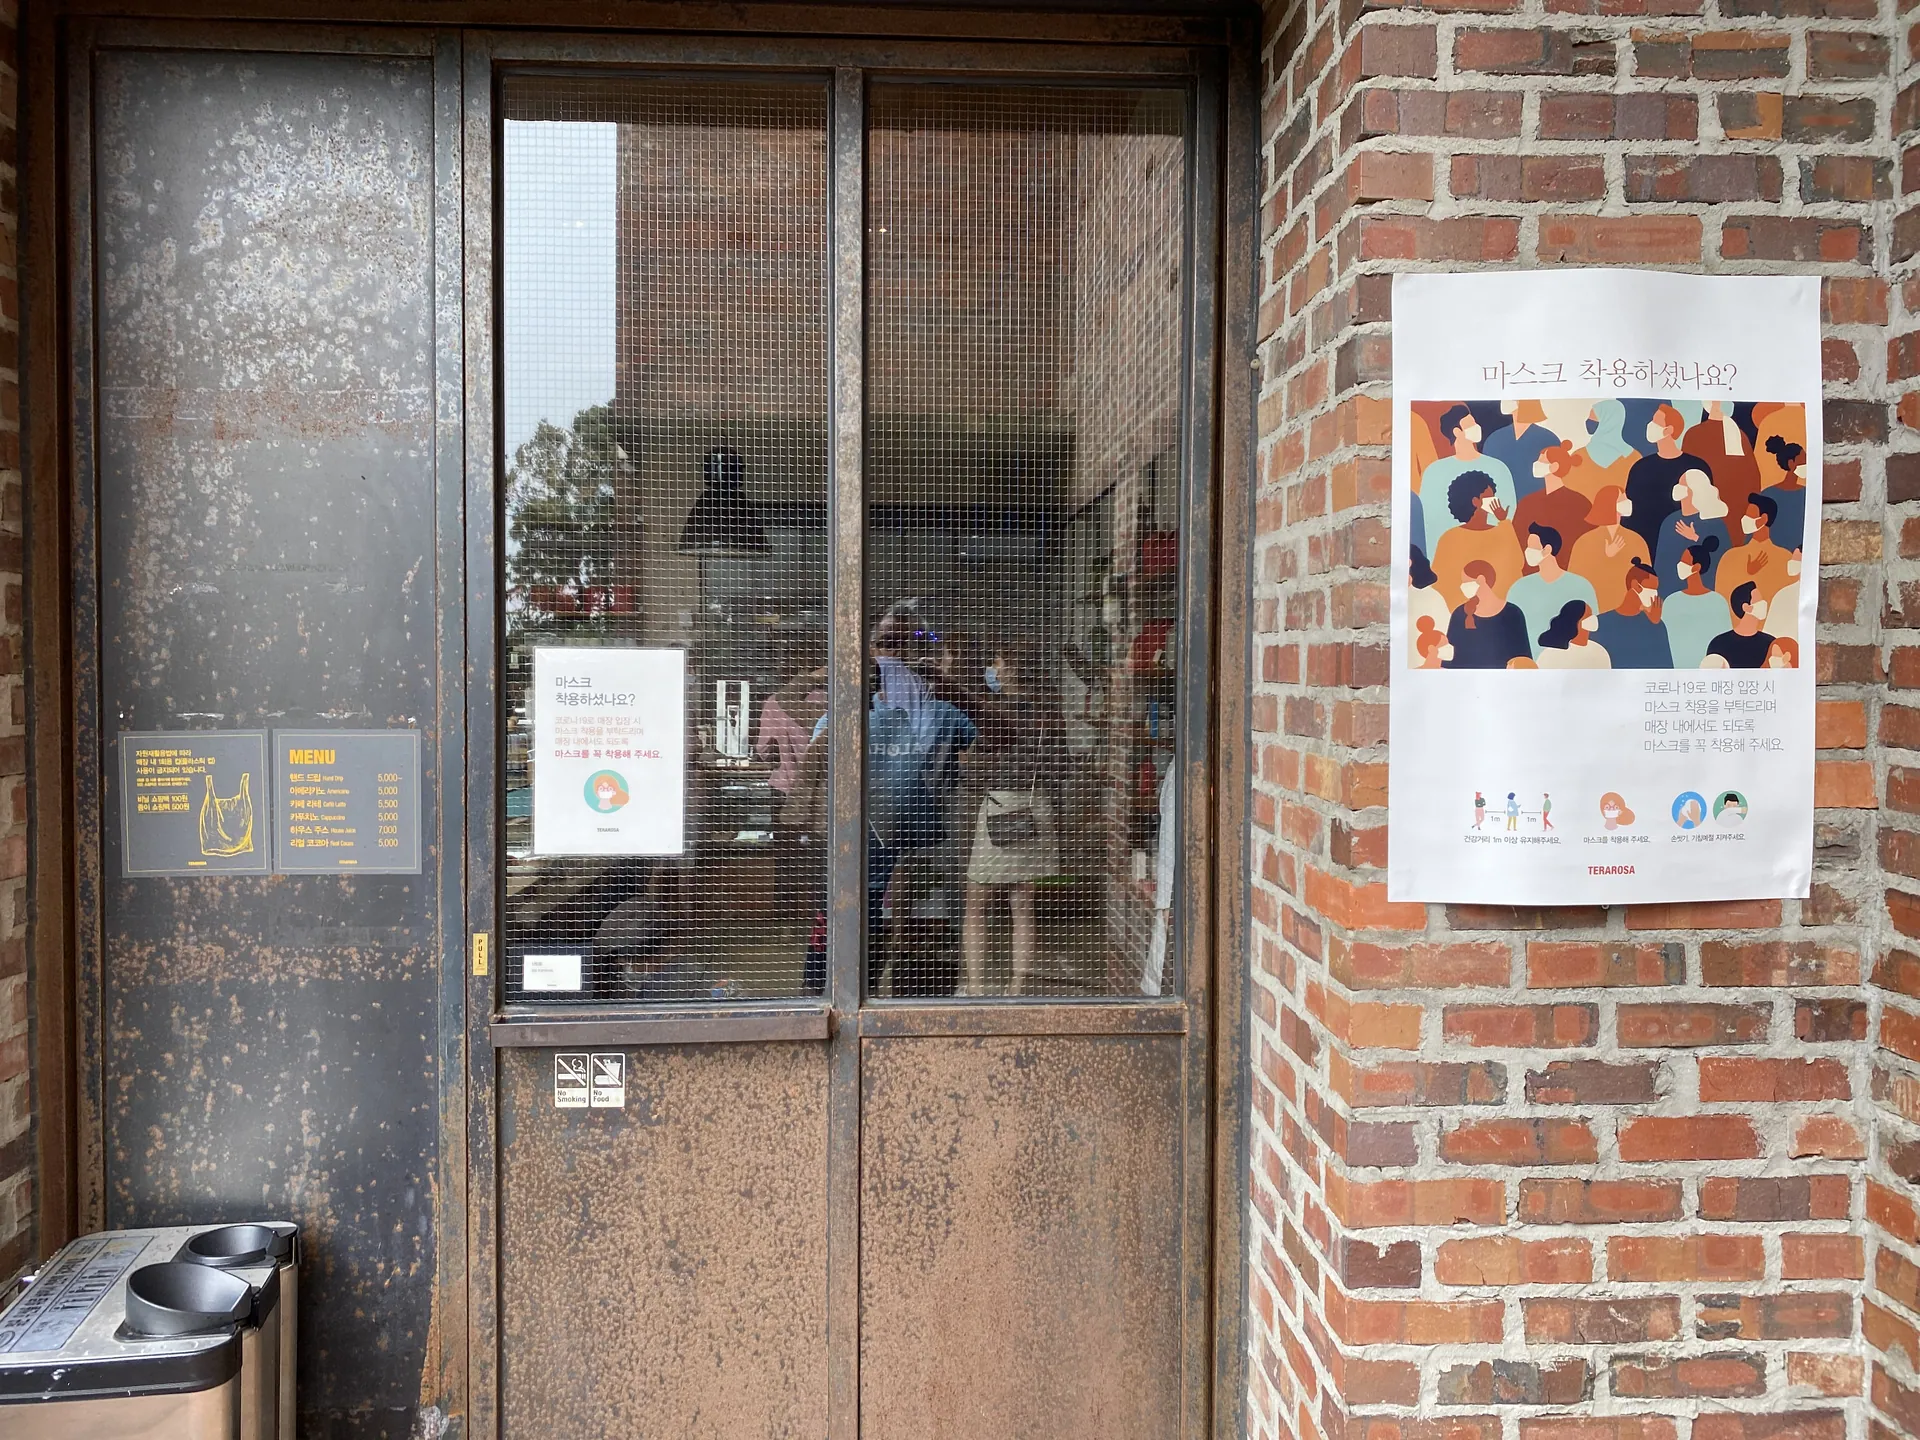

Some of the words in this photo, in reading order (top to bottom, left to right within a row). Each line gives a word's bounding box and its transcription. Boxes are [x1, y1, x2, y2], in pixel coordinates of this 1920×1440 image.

[1482, 360, 1567, 390] 마스크
[1578, 358, 1738, 391] 착용하셨나요?
[555, 676, 592, 689] 마스크
[1644, 681, 1707, 695] 코로나19로
[1711, 681, 1734, 695] 매장
[1738, 680, 1759, 695] 입장
[1763, 680, 1775, 694] 시
[555, 692, 636, 706] 착용하셨나요?
[1644, 701, 1680, 714] 마스크
[1685, 700, 1720, 714] 착용을
[1723, 700, 1777, 714] 부탁드리며
[1644, 719, 1668, 734] 매장
[1673, 719, 1718, 733] 내에서도
[1722, 719, 1755, 732] 되도록
[1644, 739, 1690, 753] 마스크를
[1695, 738, 1707, 752] 꼭
[1711, 738, 1745, 752] 착용해
[1749, 738, 1784, 752] 주세요.
[289, 749, 336, 764] MENU
[555, 749, 589, 759] 마스크를
[593, 749, 602, 758] 꼭
[605, 749, 631, 759] 착용해
[289, 773, 305, 782] 핸드
[306, 774, 321, 782] 드립
[289, 787, 326, 795] 아메리카노
[378, 787, 398, 796] 5,000
[378, 800, 398, 808] 5,500
[290, 812, 320, 821] 카푸치노
[378, 812, 398, 822] 5,000
[290, 825, 313, 834] 하우스
[314, 825, 330, 834] 주스
[378, 825, 397, 834] 7,000
[378, 838, 398, 847] 5,000
[1464, 835, 1491, 844] 건강거리
[1504, 836, 1518, 844] 이상
[1583, 836, 1608, 844] 마스크를
[1610, 836, 1629, 844] 착용해
[1588, 865, 1635, 875] TERAROSA
